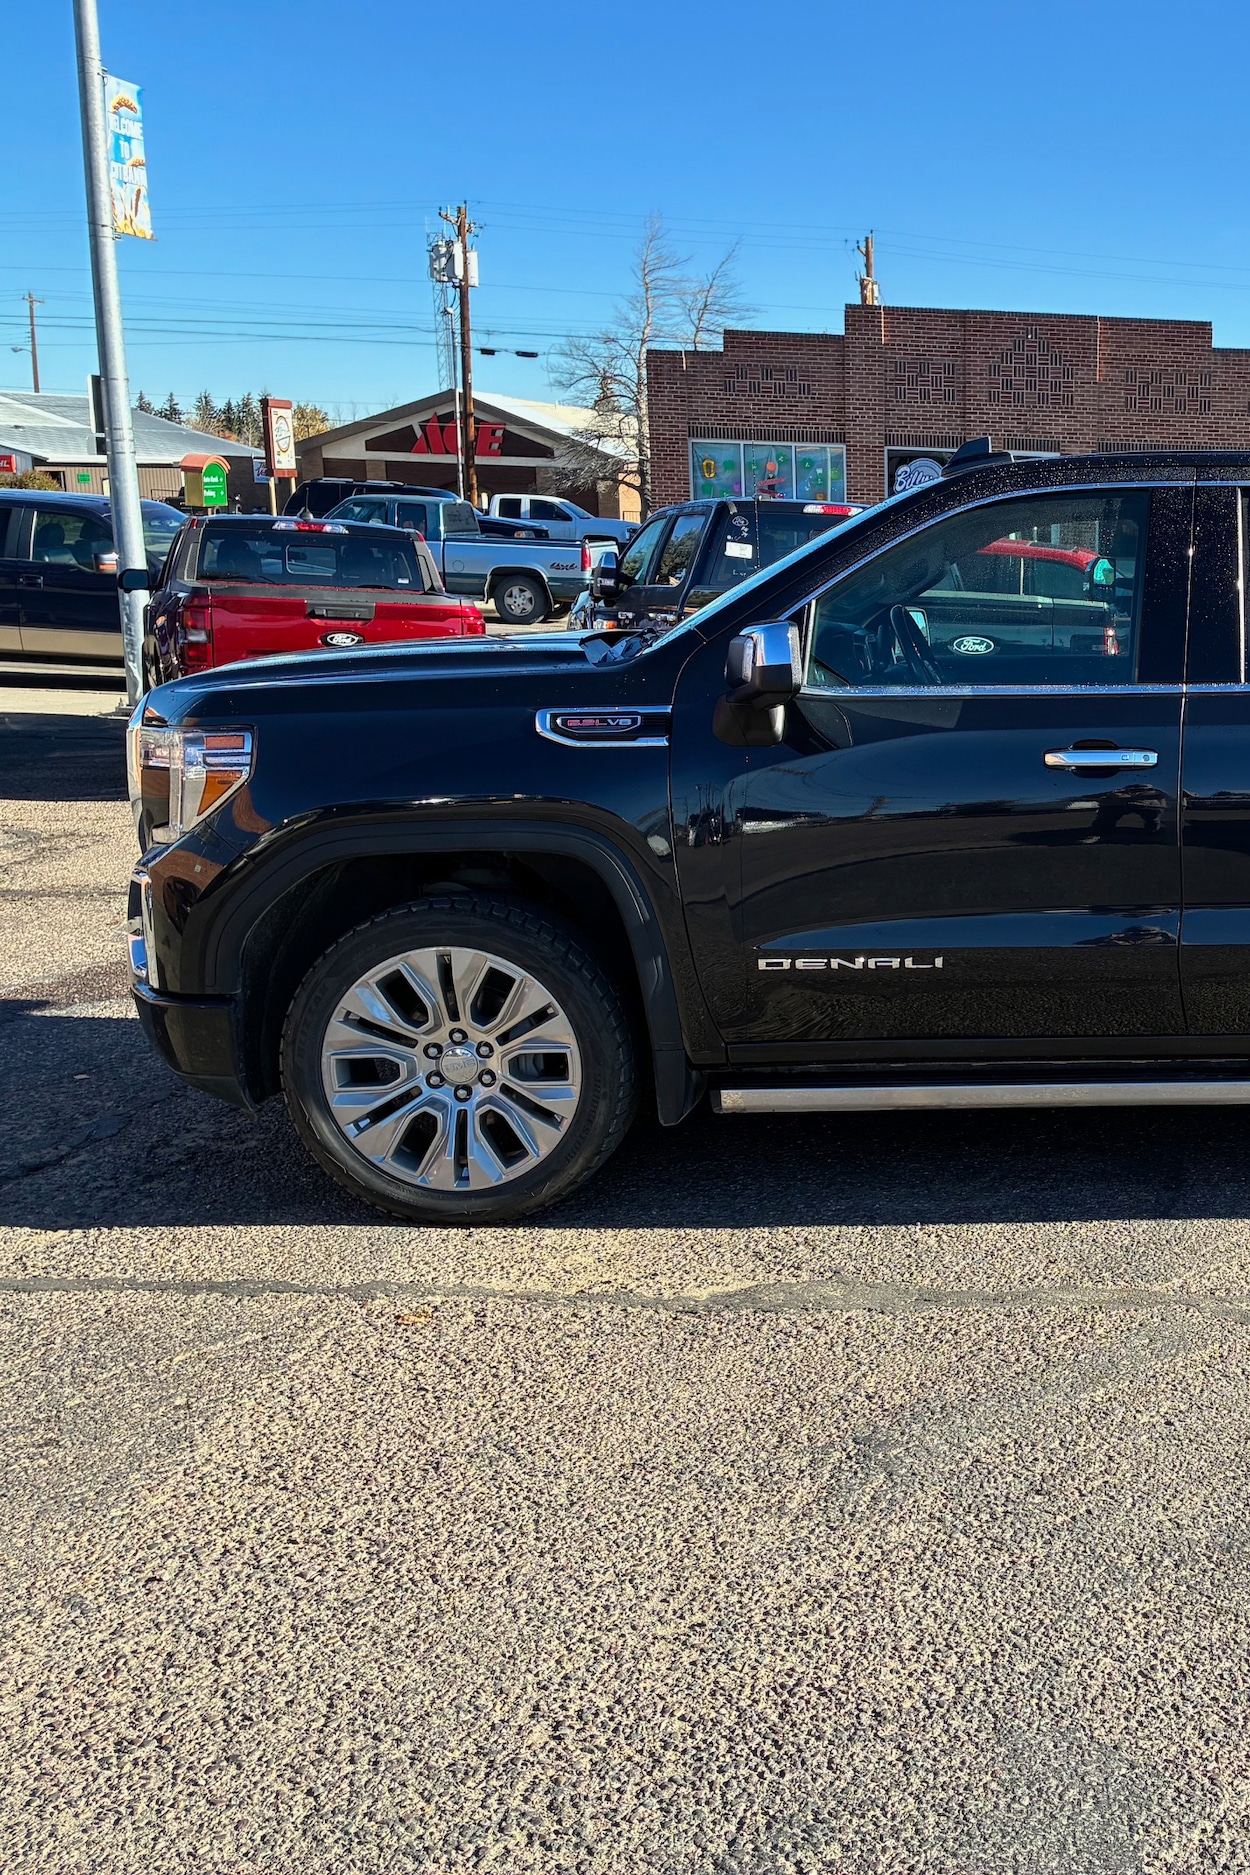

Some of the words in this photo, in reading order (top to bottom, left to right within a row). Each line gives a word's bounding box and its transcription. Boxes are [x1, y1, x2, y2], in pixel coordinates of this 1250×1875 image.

[119, 139, 131, 160] TO
[960, 638, 987, 651] Ford
[757, 956, 944, 970] DENALI
